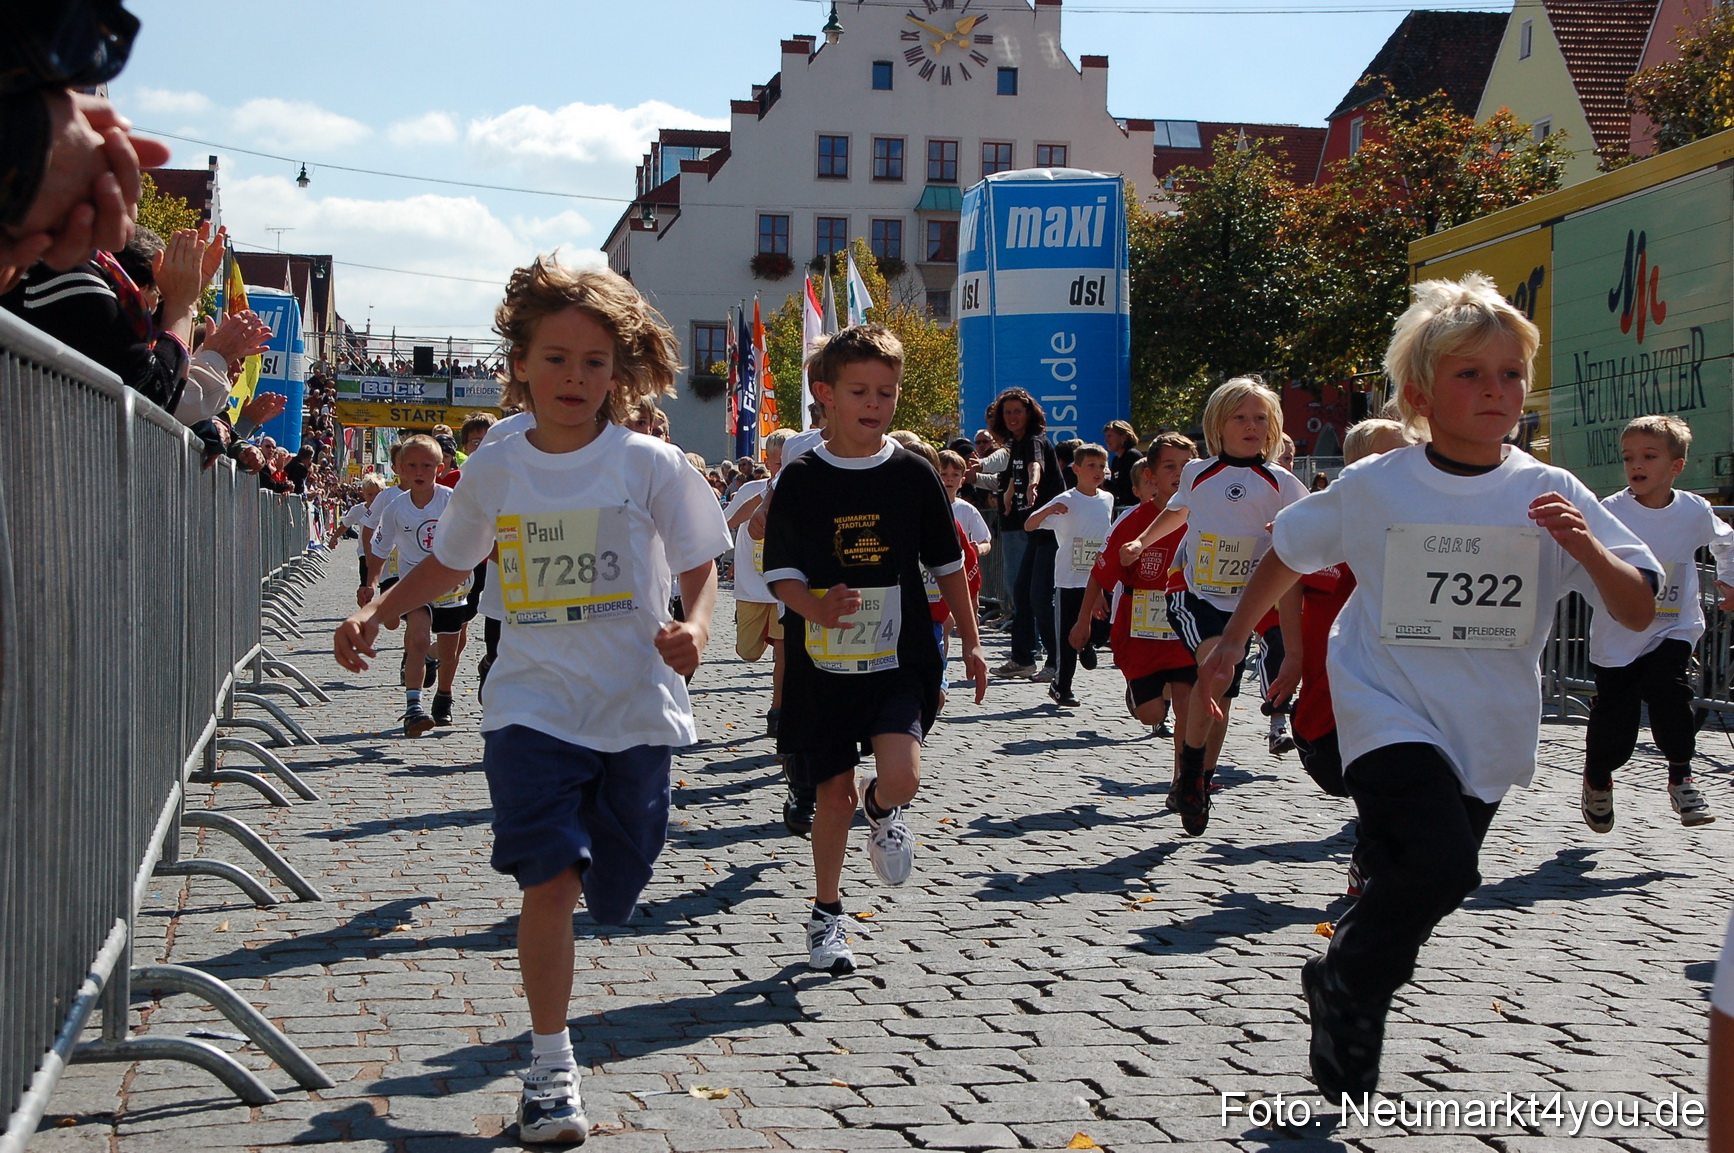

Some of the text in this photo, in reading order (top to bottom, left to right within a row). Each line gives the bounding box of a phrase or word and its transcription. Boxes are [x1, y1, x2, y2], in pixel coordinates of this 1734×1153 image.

[1005, 196, 1108, 249] maxi
[962, 278, 980, 311] dsl
[1069, 275, 1106, 306] dsl
[361, 380, 425, 396] BOCK
[390, 408, 448, 423] START
[834, 514, 880, 524] NEUMARKTER
[837, 521, 876, 529] STADTLAUF
[526, 519, 565, 543] Paul
[844, 546, 890, 555] BAMBINILAUF
[1218, 539, 1240, 553] Paul
[1423, 535, 1482, 555] CHRIS
[502, 557, 519, 574] K4
[1140, 562, 1160, 571] NEU
[1199, 554, 1209, 565] K4
[531, 550, 622, 588] 7283
[1426, 571, 1524, 608] 7322
[582, 600, 633, 615] PFLEIDERER
[1395, 625, 1432, 635] BOCK
[1467, 626, 1517, 637] PFLEIDERER
